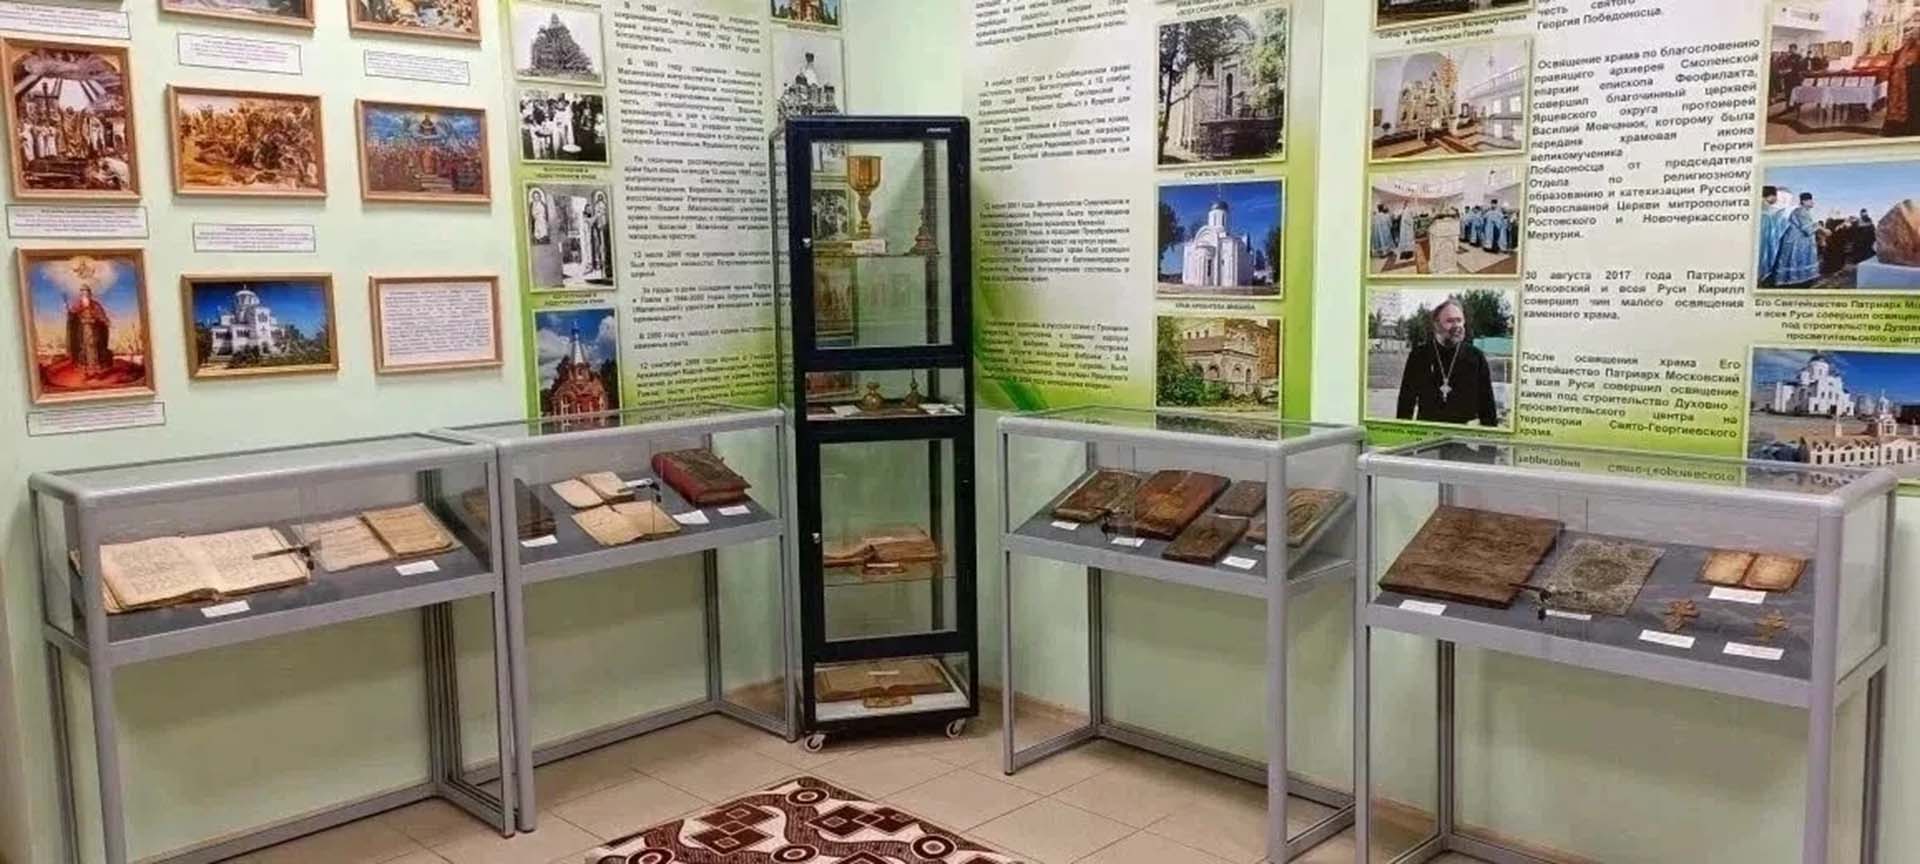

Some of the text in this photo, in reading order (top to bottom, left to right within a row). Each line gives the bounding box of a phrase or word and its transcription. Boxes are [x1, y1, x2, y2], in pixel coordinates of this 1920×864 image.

[1538, 0, 1635, 17] честь святого
[1537, 17, 1580, 30] Георгия
[1538, 39, 1760, 69] Освящение храма по благословению
[1534, 53, 1758, 83] правящего архиерея Смоленской
[1534, 68, 1758, 96] епархии епископа Феофилакта,
[1533, 82, 1757, 109] совершил благочинный церквей
[1533, 98, 1756, 122] Ярцевского округа протоиерей
[1532, 124, 1579, 136] Василий
[1655, 114, 1713, 128] которому
[1721, 112, 1755, 123] была
[1531, 126, 1754, 150] передана храмовая икона
[1530, 141, 1753, 162] великомученика Георгия
[1529, 156, 1753, 176] Победоносца от председателя
[1529, 170, 1752, 188] Отдела по религиозному
[1529, 190, 1603, 201] образованию
[1620, 186, 1695, 197] катехизации
[1700, 183, 1751, 196] Русской
[1529, 199, 1750, 214] Православной Церкви митрополита
[1528, 216, 1597, 226] Ростовского
[1643, 213, 1750, 224] Новочеркасского
[1527, 230, 1583, 242] Меркурия.
[1525, 271, 1745, 283] 30 августа 2017 года Патриарх
[1525, 283, 1745, 296] Московский и всея Руси Кирилл
[1524, 297, 1744, 309] совершил чин малого освящения
[1774, 299, 1848, 308] Святейшество
[1851, 300, 1900, 310] Патриарх
[1523, 311, 1620, 321] каменного храма.
[1790, 310, 1813, 319] Руси
[1817, 311, 1869, 319] совершил
[1781, 322, 1799, 330] под
[1803, 323, 1880, 331] строительство
[1786, 332, 1887, 342] просветительского
[1522, 352, 1741, 370] После освящения храма Его
[1521, 365, 1740, 383] Святейшество Патриарх Московский
[1521, 378, 1739, 397] и всея Руси совершил освящение
[1521, 391, 1552, 399] камня
[1557, 392, 1577, 402] под
[1583, 393, 1669, 407] строительство
[1674, 398, 1728, 411] Духовно
[1520, 403, 1737, 424] просветительского центра на
[1520, 414, 1736, 438] территории Свято-Георгиевского
